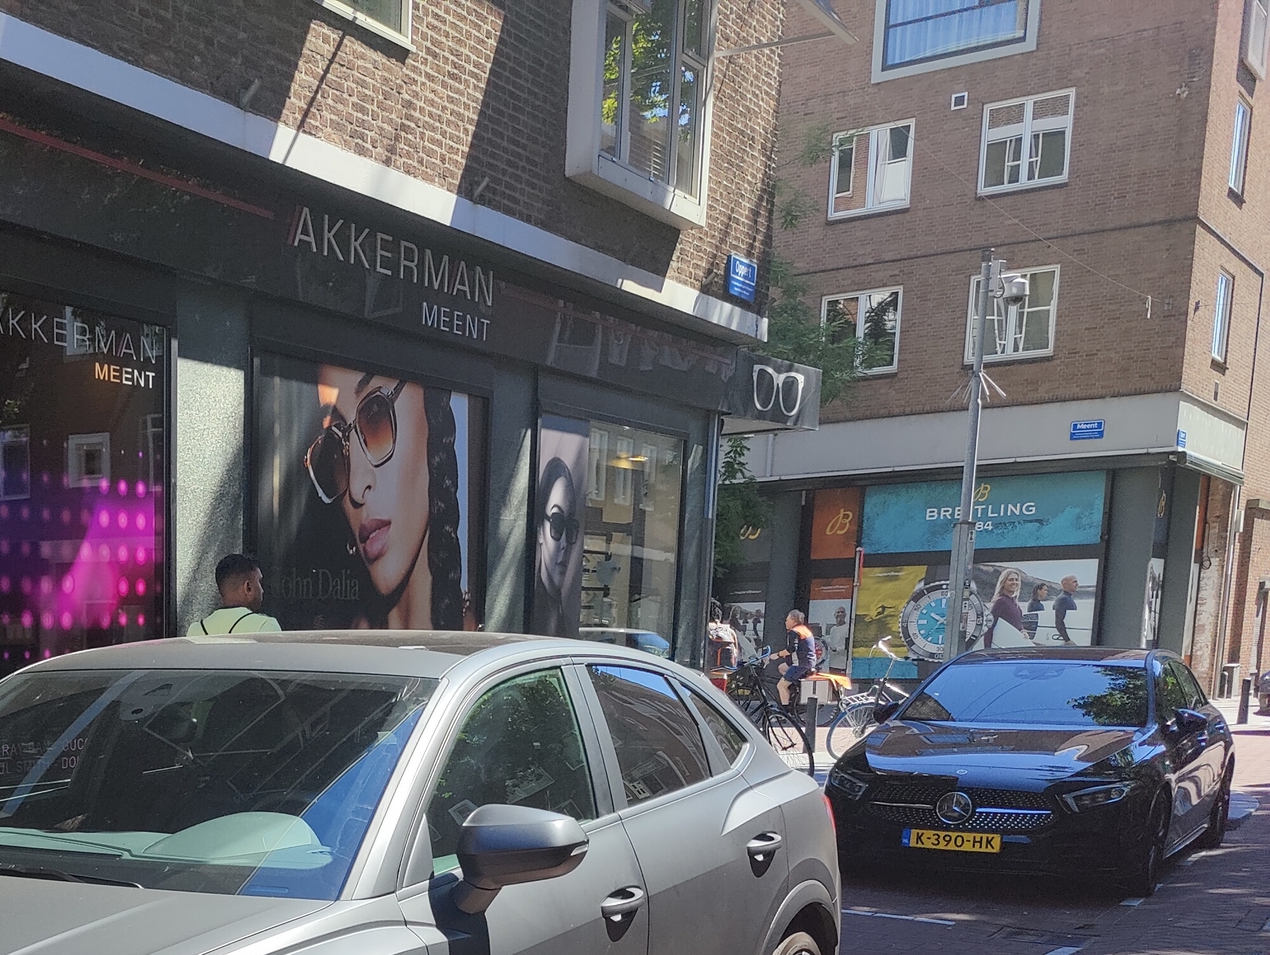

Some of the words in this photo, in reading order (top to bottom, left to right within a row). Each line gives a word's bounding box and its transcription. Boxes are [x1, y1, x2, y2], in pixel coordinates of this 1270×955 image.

[288, 206, 495, 307] AKKERMAN
[422, 301, 491, 341] MEENT
[94, 361, 156, 389] MEENT
[1076, 422, 1099, 430] Meent
[925, 502, 1037, 521] BRETLING
[316, 567, 360, 601] Dalia
[914, 831, 996, 850] K-390-HK
